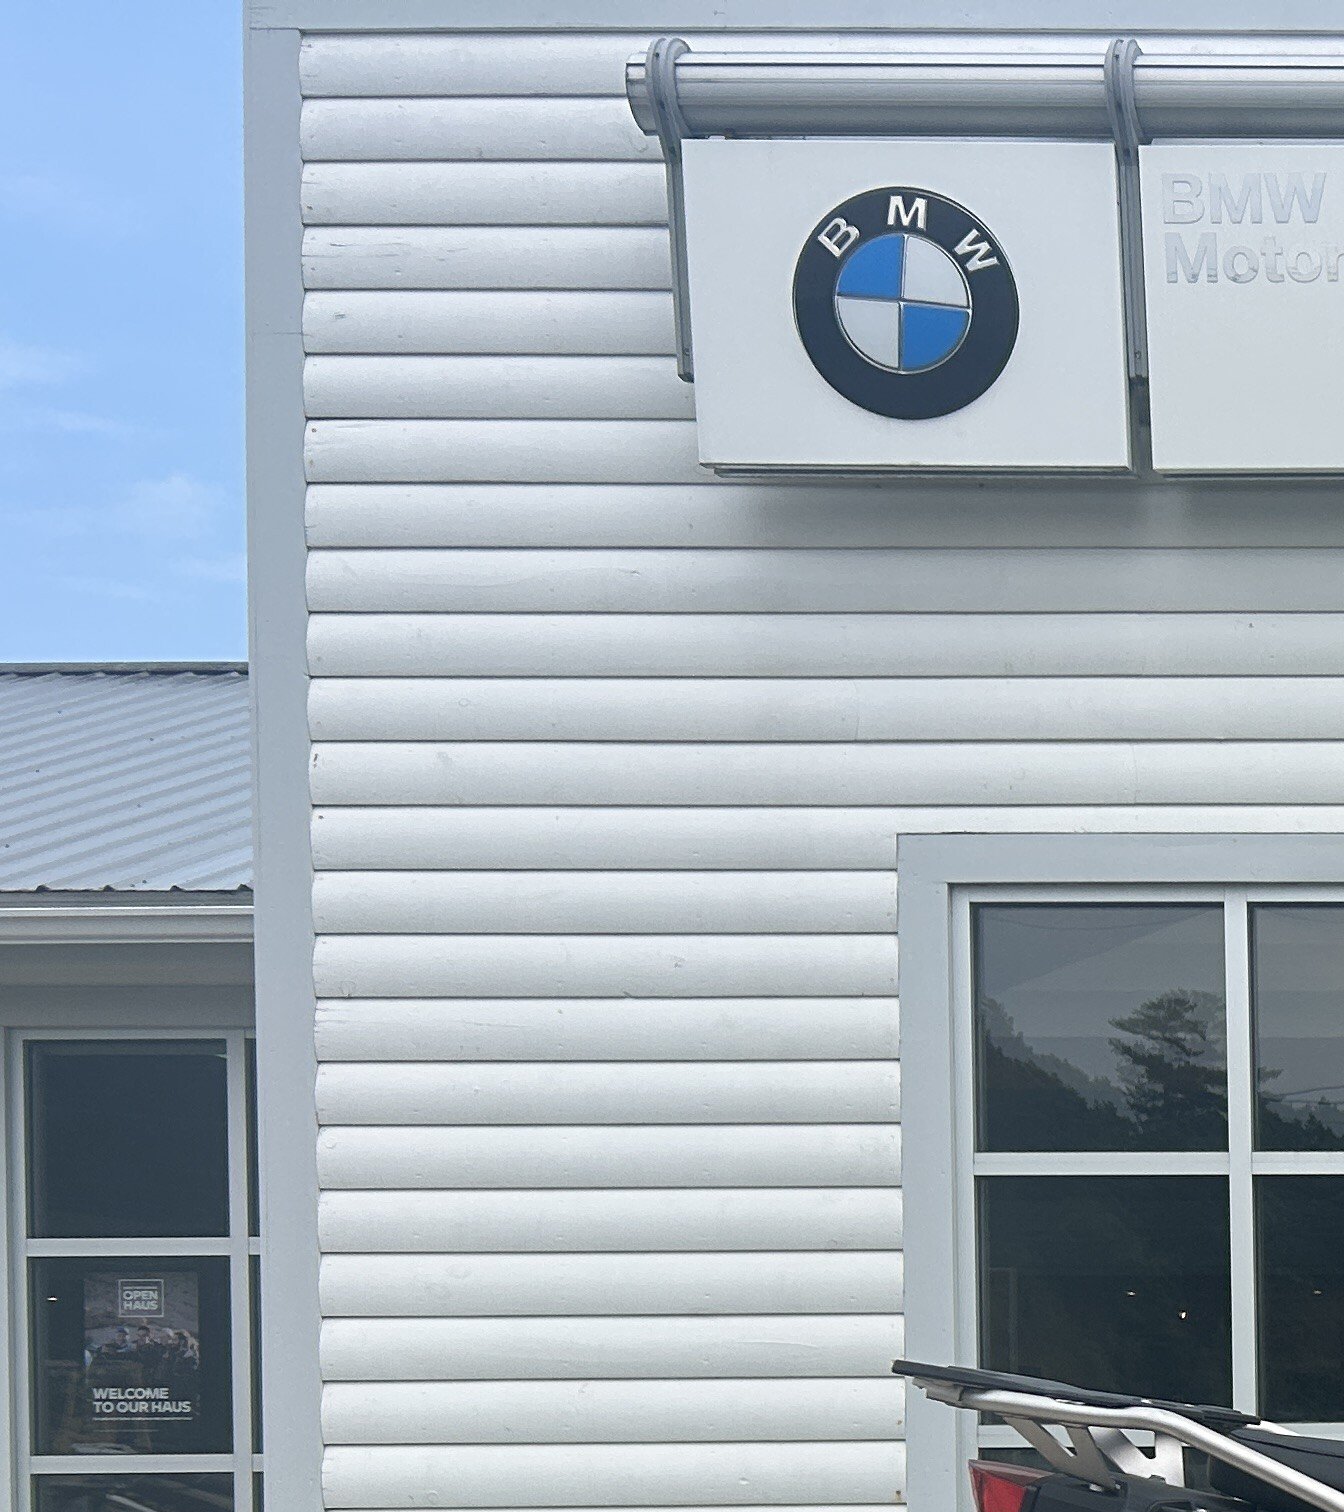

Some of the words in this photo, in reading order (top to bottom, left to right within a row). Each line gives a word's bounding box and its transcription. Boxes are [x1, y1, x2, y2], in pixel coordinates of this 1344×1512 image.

[1162, 173, 1326, 224] BMW
[818, 196, 999, 273] BMW
[123, 1290, 158, 1300] OPEN
[123, 1301, 158, 1310] HAUS
[93, 1388, 169, 1399] WELCOME
[93, 1401, 114, 1413] TO
[116, 1401, 148, 1413] OUR
[152, 1401, 192, 1413] HAUS
